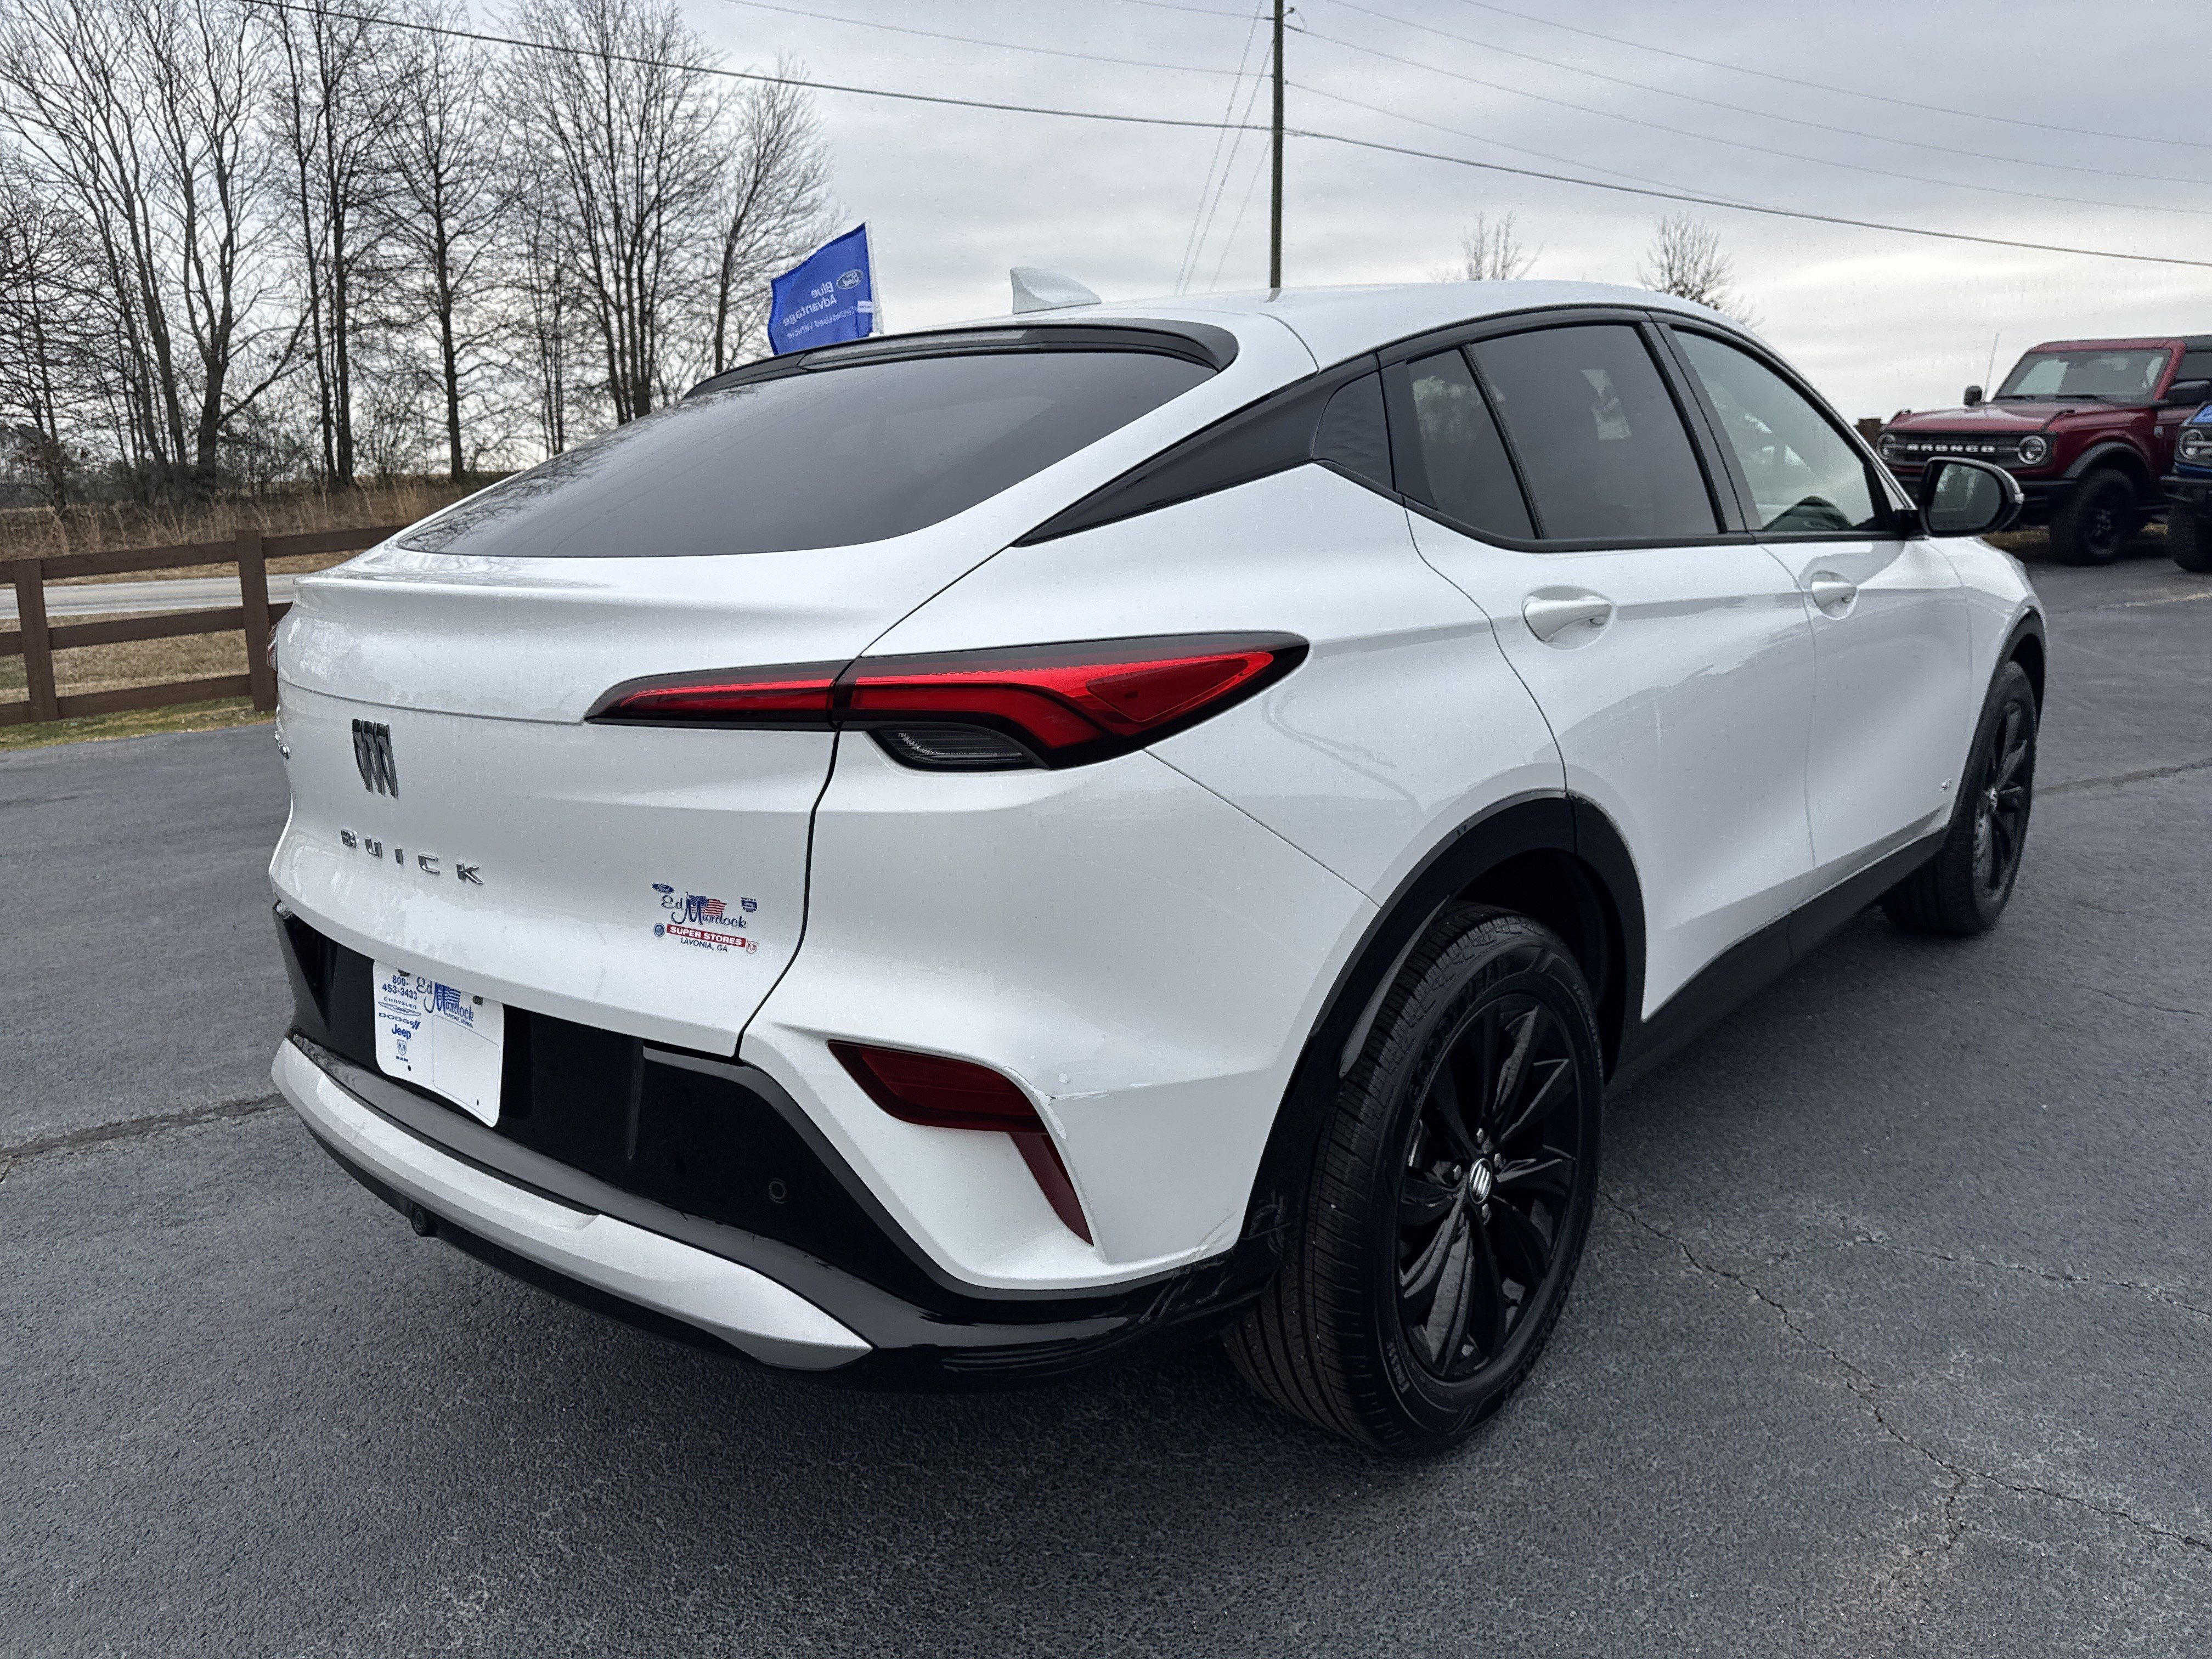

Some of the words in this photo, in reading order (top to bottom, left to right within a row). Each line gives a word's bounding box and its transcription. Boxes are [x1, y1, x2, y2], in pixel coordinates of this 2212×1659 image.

[1906, 443, 1995, 453] BRONCO
[340, 828, 483, 885] BUICK
[661, 895, 684, 910] Ed
[671, 899, 747, 928] Murdock
[670, 926, 701, 938] SUPER
[703, 933, 742, 945] STORES
[680, 937, 714, 951] LAVONIA,
[716, 944, 728, 952] GA
[392, 975, 409, 986] 800-
[416, 977, 433, 995] Ed
[382, 983, 417, 1000] 453-3433
[383, 997, 417, 1009] CHRYSLER
[424, 982, 474, 1022] Murdock
[379, 1012, 415, 1026] DODGE
[391, 1023, 411, 1041] Jeep
